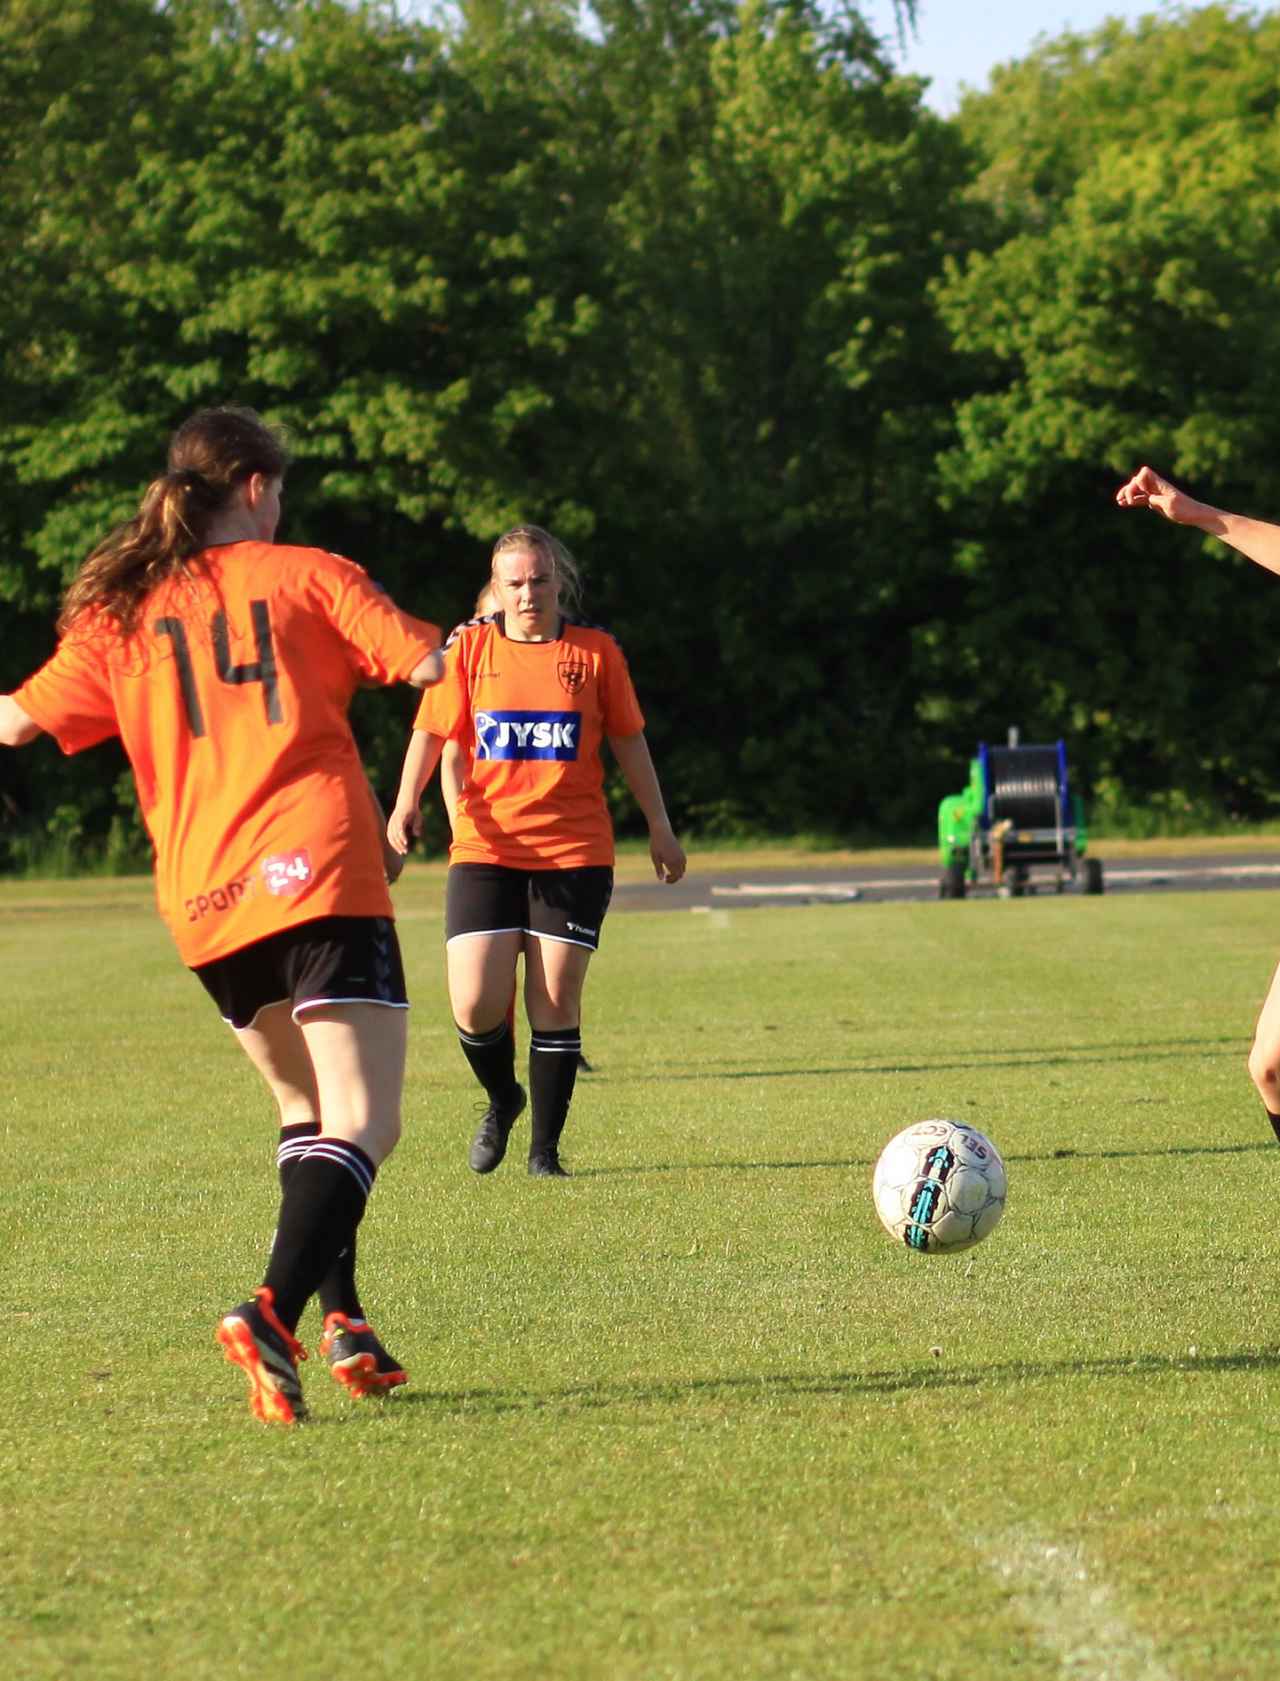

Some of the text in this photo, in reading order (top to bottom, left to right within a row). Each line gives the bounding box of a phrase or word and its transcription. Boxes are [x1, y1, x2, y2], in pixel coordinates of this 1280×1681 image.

[154, 599, 284, 739] 14
[495, 722, 576, 748] JYSK
[267, 857, 310, 889] 24
